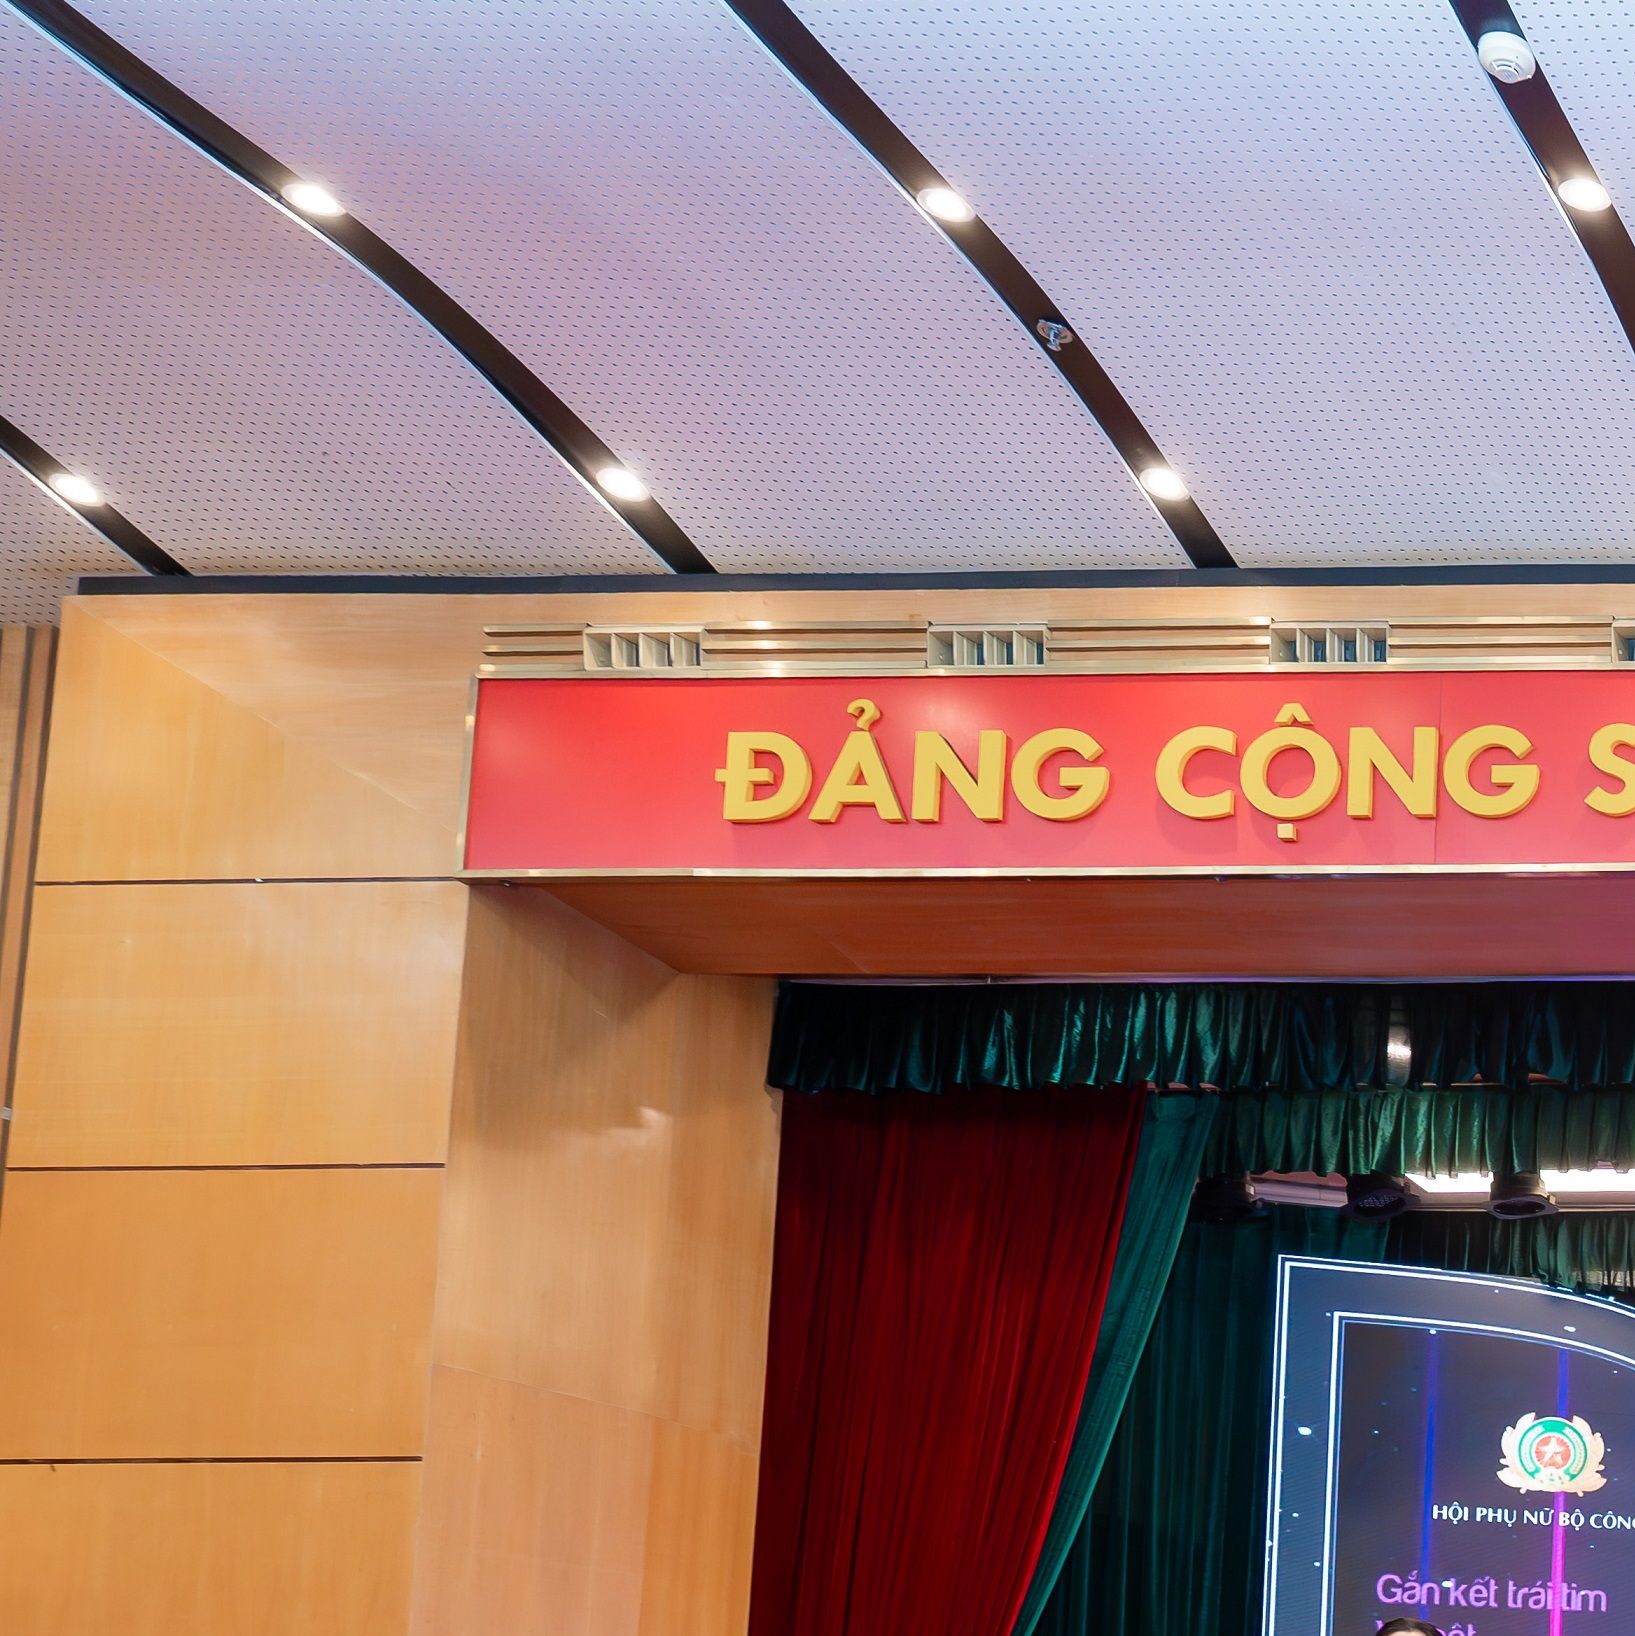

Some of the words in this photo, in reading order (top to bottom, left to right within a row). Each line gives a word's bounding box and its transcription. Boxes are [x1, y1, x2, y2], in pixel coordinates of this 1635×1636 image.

[715, 697, 1112, 826] ĐẢNG
[1154, 701, 1541, 842] CỘNG
[1432, 1501, 1469, 1523] HỘI
[1476, 1507, 1517, 1527] PHỤ
[1523, 1506, 1555, 1527] NỮ
[1558, 1509, 1585, 1531] BỘ
[1376, 1570, 1440, 1606] Gắn
[1448, 1574, 1498, 1608] kết
[1507, 1579, 1553, 1611] trái
[1561, 1583, 1608, 1613] tim
